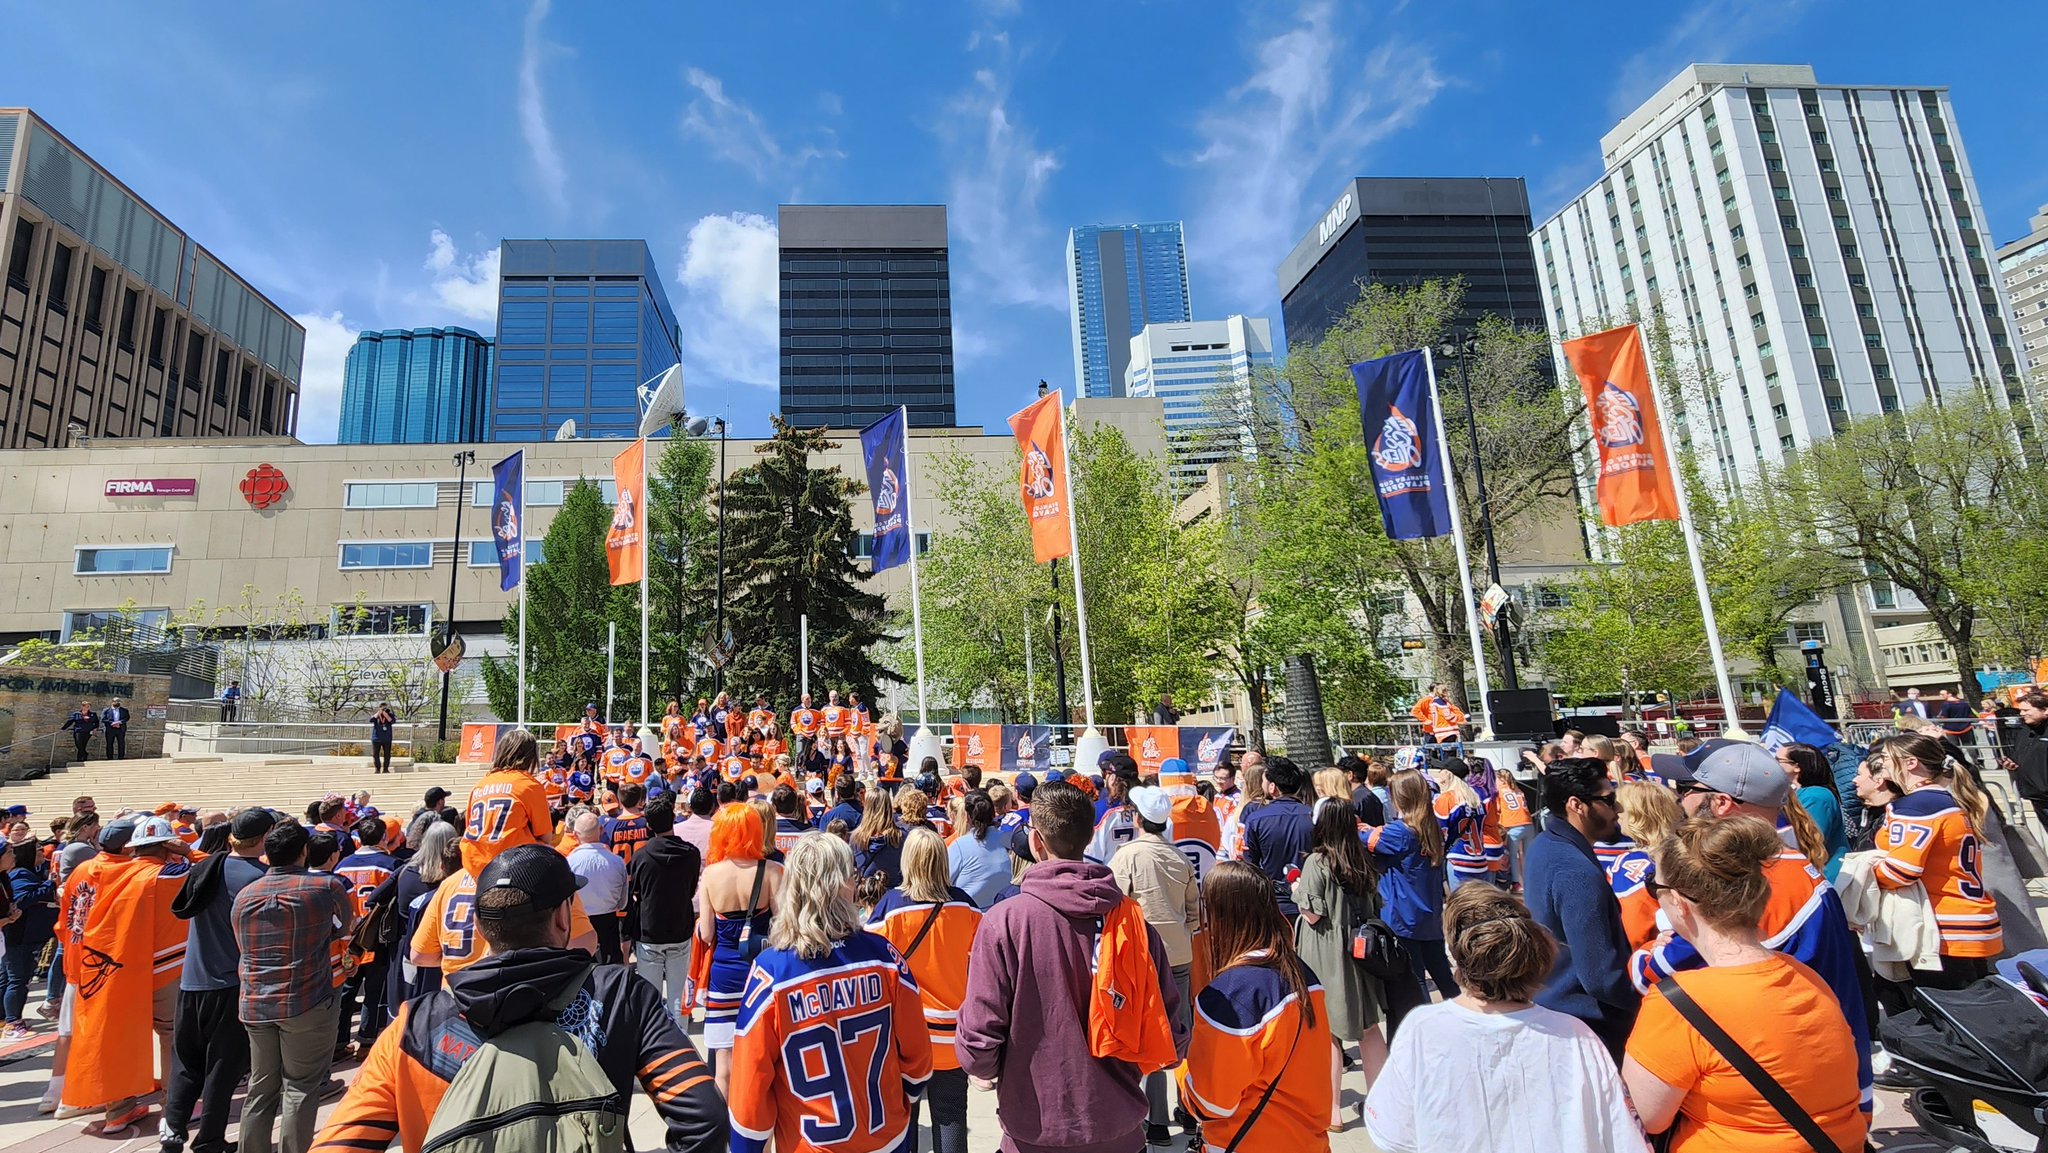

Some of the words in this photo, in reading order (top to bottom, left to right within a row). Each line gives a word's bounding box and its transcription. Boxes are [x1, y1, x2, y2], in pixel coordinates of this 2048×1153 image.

[1319, 193, 1352, 246] MNP
[106, 481, 154, 493] FIRMA
[463, 797, 515, 842] 97
[613, 828, 650, 842] DRAISAITL
[1889, 820, 1933, 850] 97
[1958, 833, 1984, 900] 9
[443, 892, 477, 959] 9
[742, 960, 775, 1009] 7
[787, 972, 882, 1024] McDAVID
[781, 1003, 893, 1146] 97
